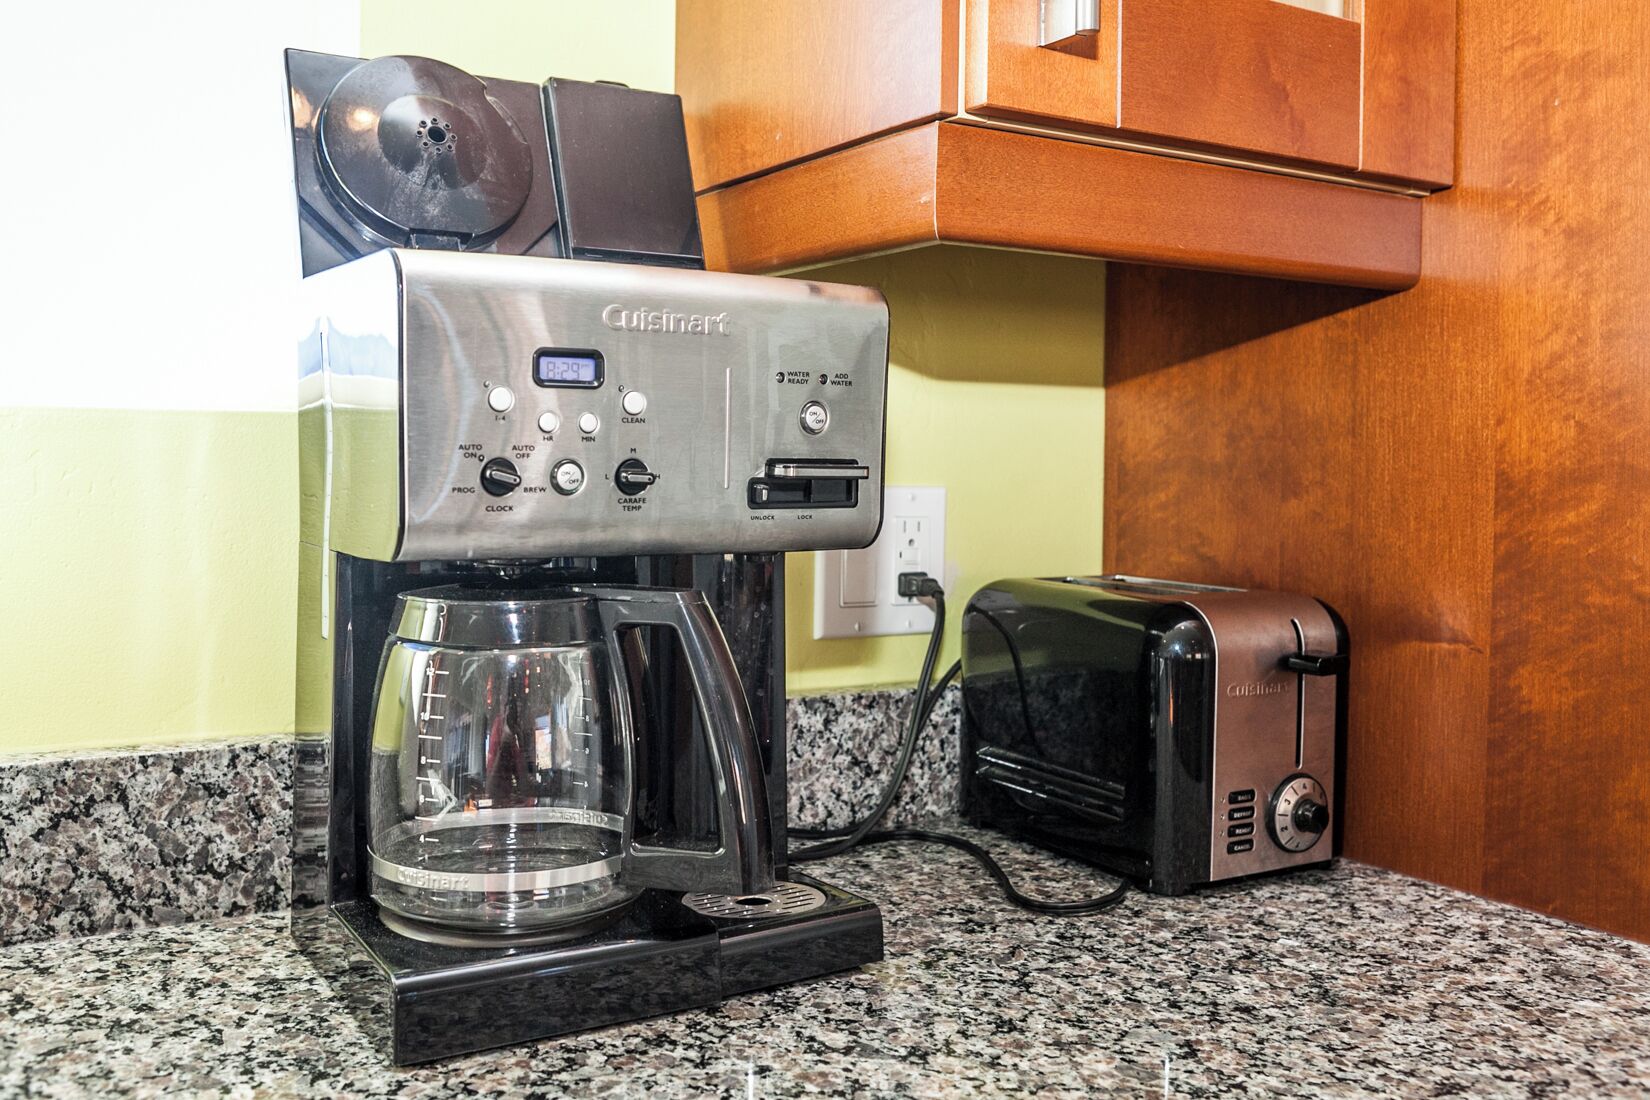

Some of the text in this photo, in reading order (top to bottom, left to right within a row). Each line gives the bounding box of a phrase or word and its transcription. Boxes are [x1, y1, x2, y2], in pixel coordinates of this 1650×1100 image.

[603, 304, 732, 336] Cuisinart
[546, 360, 580, 381] 8:29
[621, 416, 646, 424] CLEAN
[458, 443, 483, 451] AUTO
[511, 444, 536, 452] AUTO
[515, 452, 531, 460] OFF
[451, 486, 476, 494] PROG
[420, 712, 430, 720] 10
[420, 756, 426, 764] 8
[397, 867, 470, 891] Cuisinart
